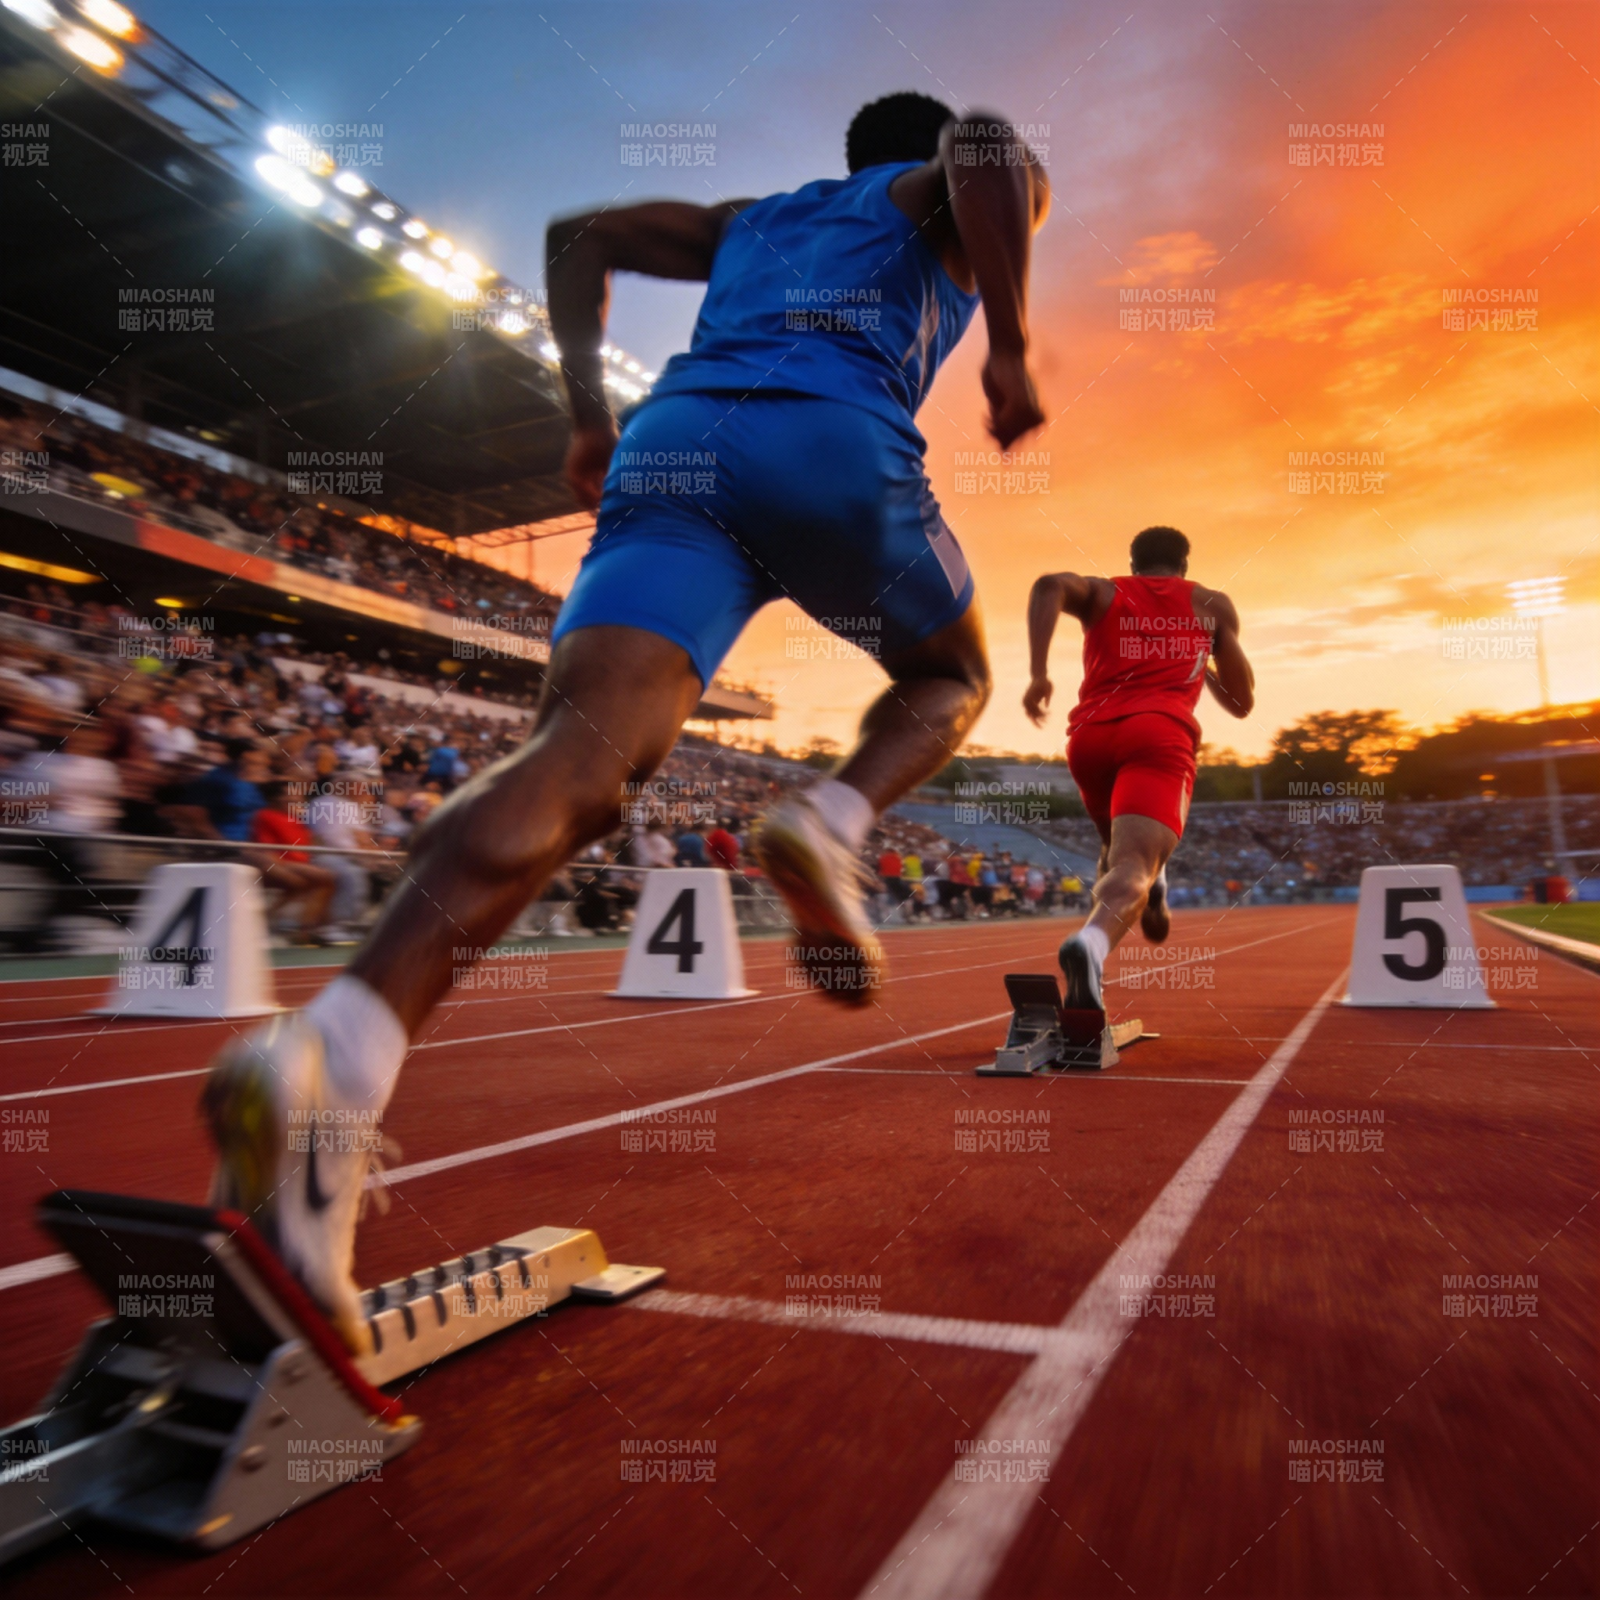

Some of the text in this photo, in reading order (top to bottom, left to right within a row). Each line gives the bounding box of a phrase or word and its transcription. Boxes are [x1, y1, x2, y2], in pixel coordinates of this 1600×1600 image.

[148, 887, 213, 986] 4
[646, 888, 703, 973] 4
[1382, 887, 1447, 982] 5
